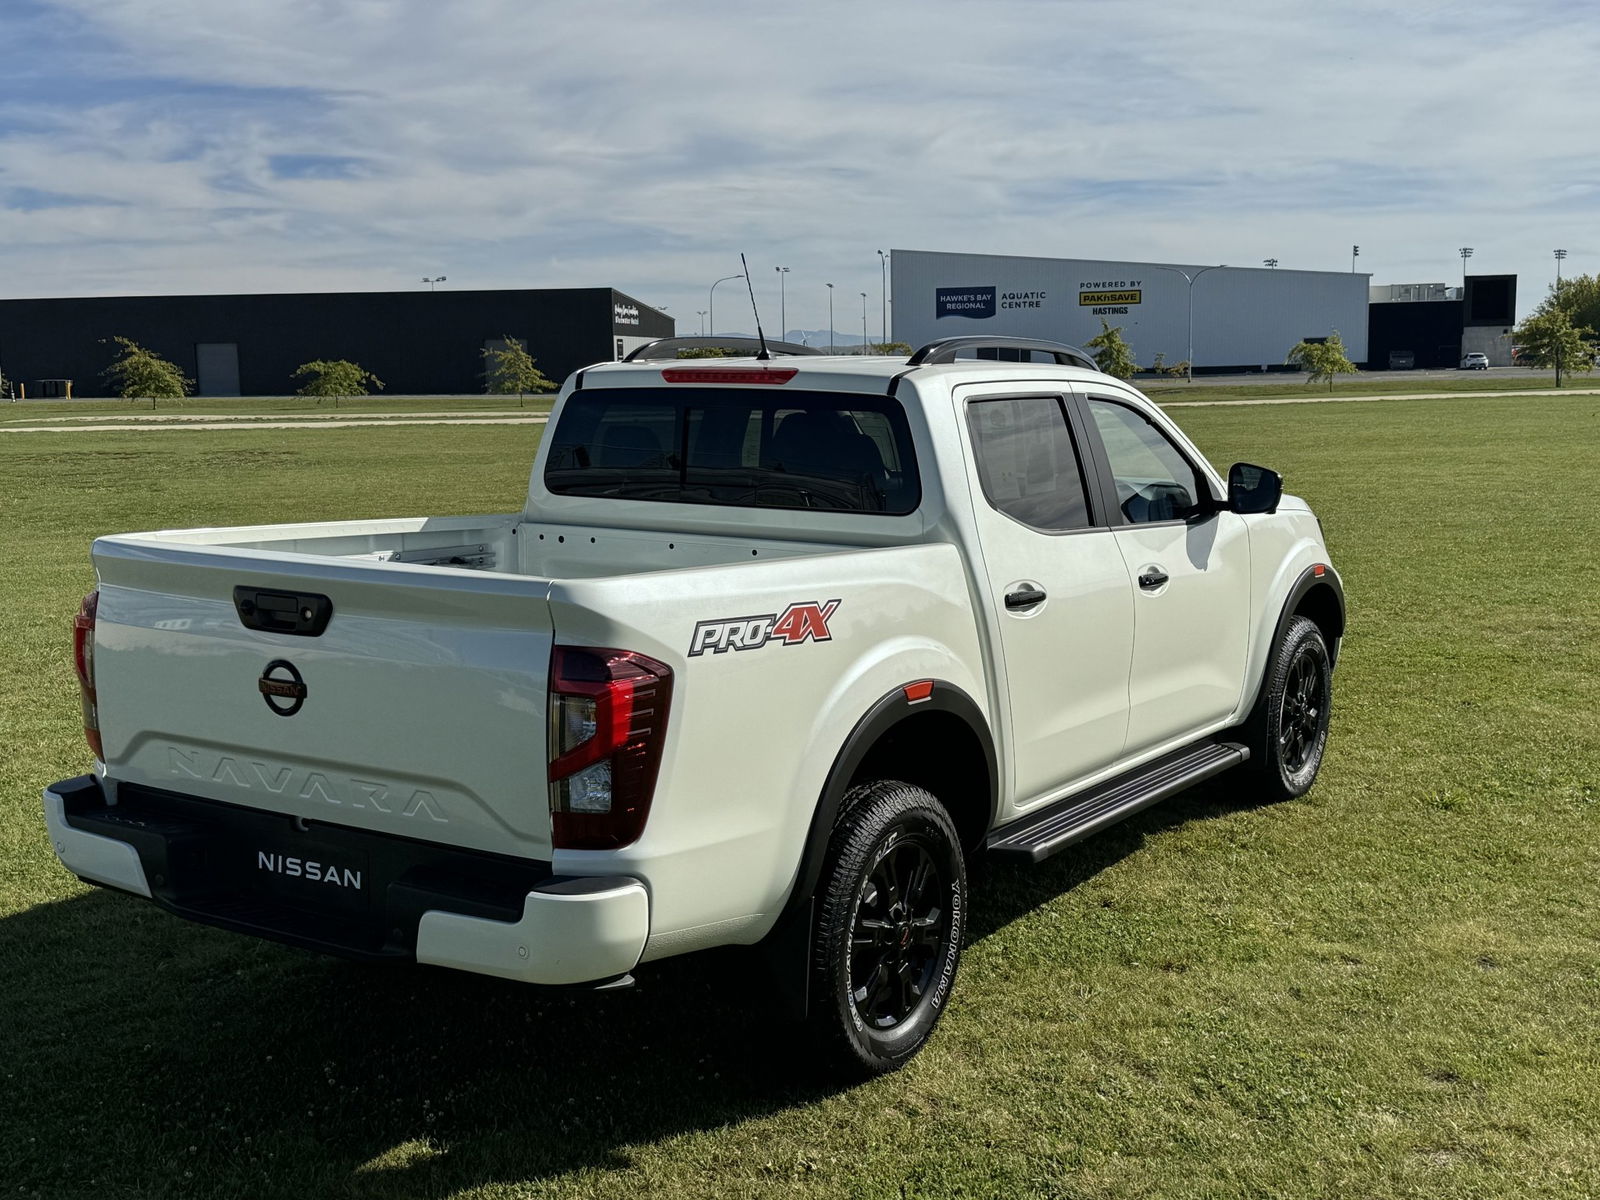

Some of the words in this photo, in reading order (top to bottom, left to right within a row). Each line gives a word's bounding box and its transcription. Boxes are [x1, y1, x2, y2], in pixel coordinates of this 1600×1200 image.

[1080, 281, 1126, 289] POWERED
[1001, 291, 1047, 300] AQUATIC
[946, 302, 986, 310] REGIONAL
[1001, 301, 1041, 309] CENTRE
[1092, 306, 1129, 315] HASTINGS
[168, 746, 449, 823] NAVARA
[258, 850, 362, 890] NISSAN
[930, 878, 962, 1010] YOKOHAMA
